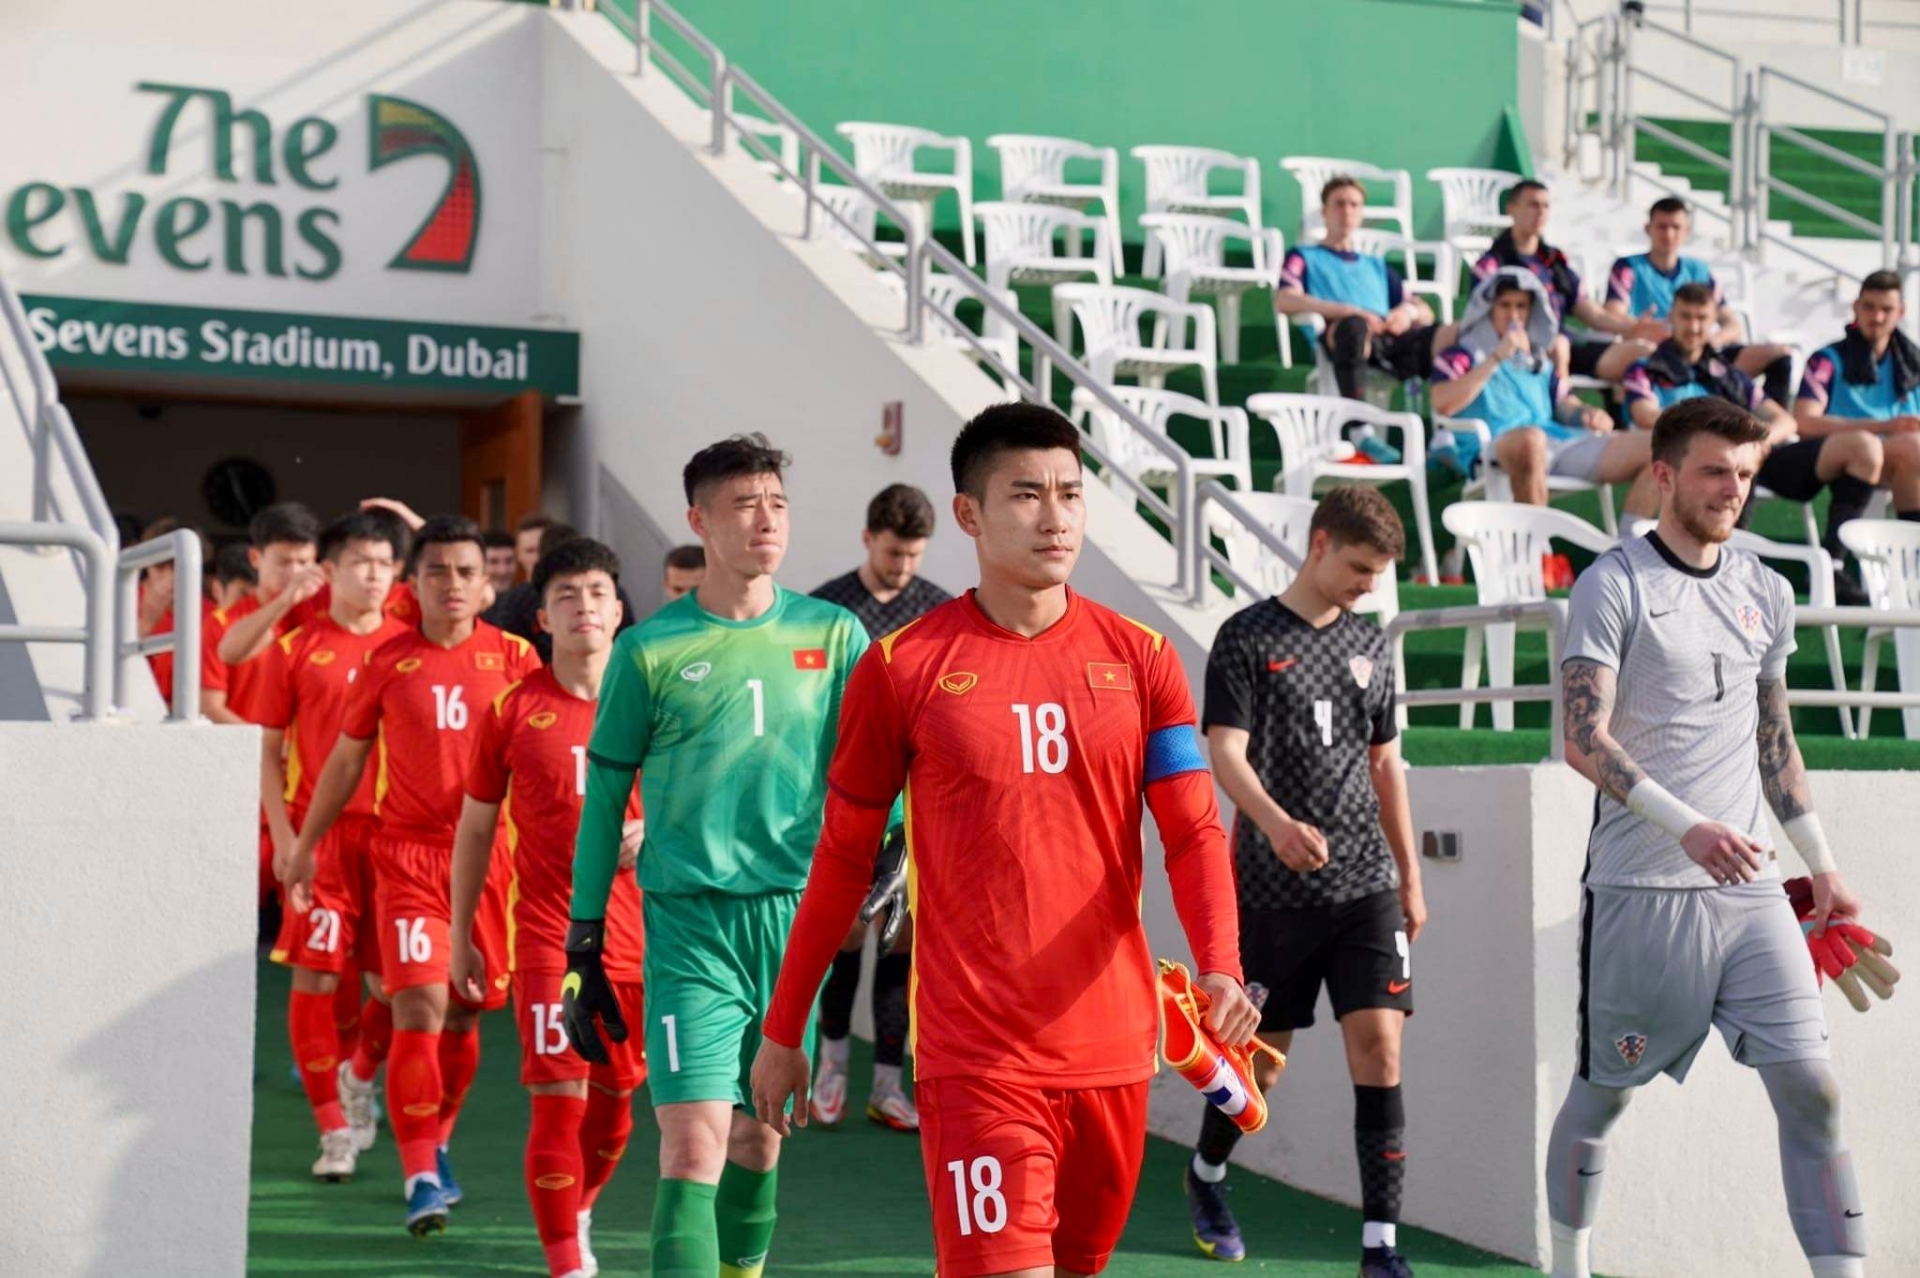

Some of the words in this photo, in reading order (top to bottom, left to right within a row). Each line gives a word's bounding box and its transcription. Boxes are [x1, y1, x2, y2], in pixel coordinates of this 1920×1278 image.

[132, 81, 341, 191] The
[28, 306, 190, 360] Sevens
[200, 319, 394, 377] Stadium,
[407, 333, 529, 380] Dubai
[1710, 652, 1725, 702] 1
[431, 684, 469, 731] 16
[746, 679, 764, 737] 1
[1314, 700, 1333, 746] 4
[1011, 702, 1069, 774] 18
[570, 745, 586, 797] 1
[306, 908, 341, 953] 21
[394, 916, 433, 964] 16
[531, 1003, 570, 1055] 15
[660, 1014, 681, 1072] 1
[947, 1155, 1008, 1236] 18
